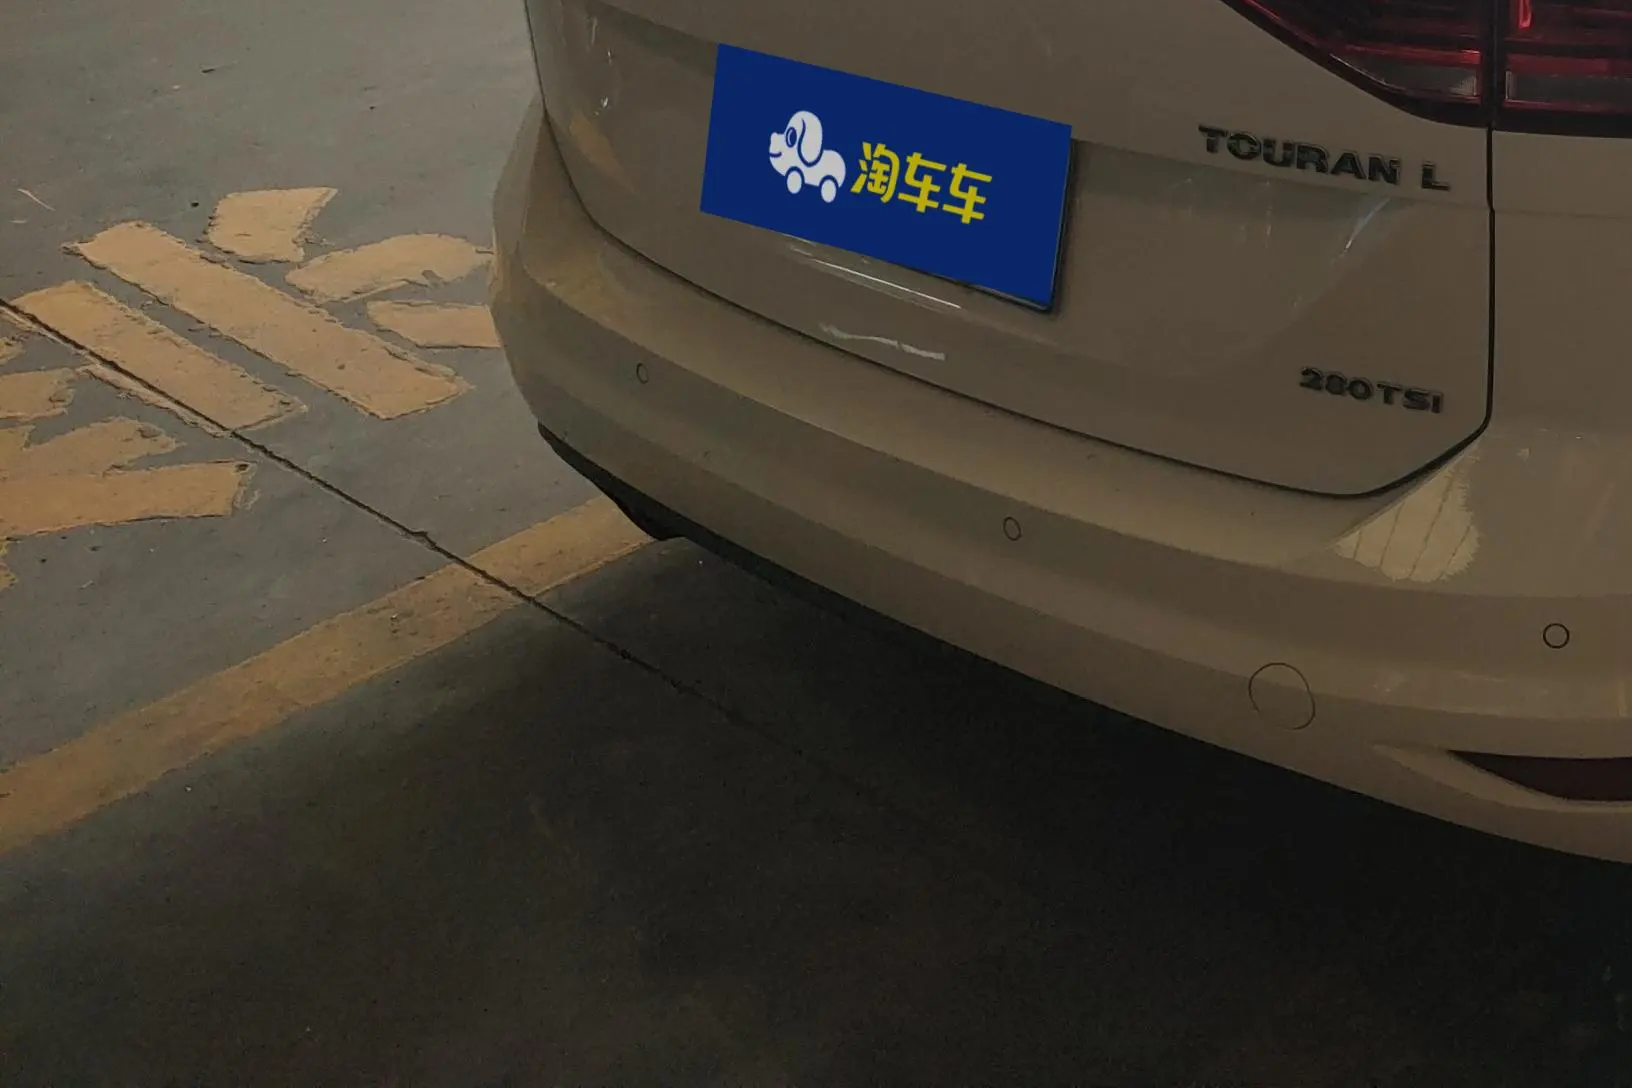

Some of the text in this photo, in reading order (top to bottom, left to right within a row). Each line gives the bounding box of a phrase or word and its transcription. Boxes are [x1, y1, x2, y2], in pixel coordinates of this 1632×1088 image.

[1198, 124, 1451, 192] TOURAN L
[1299, 367, 1444, 414] 280TSI
